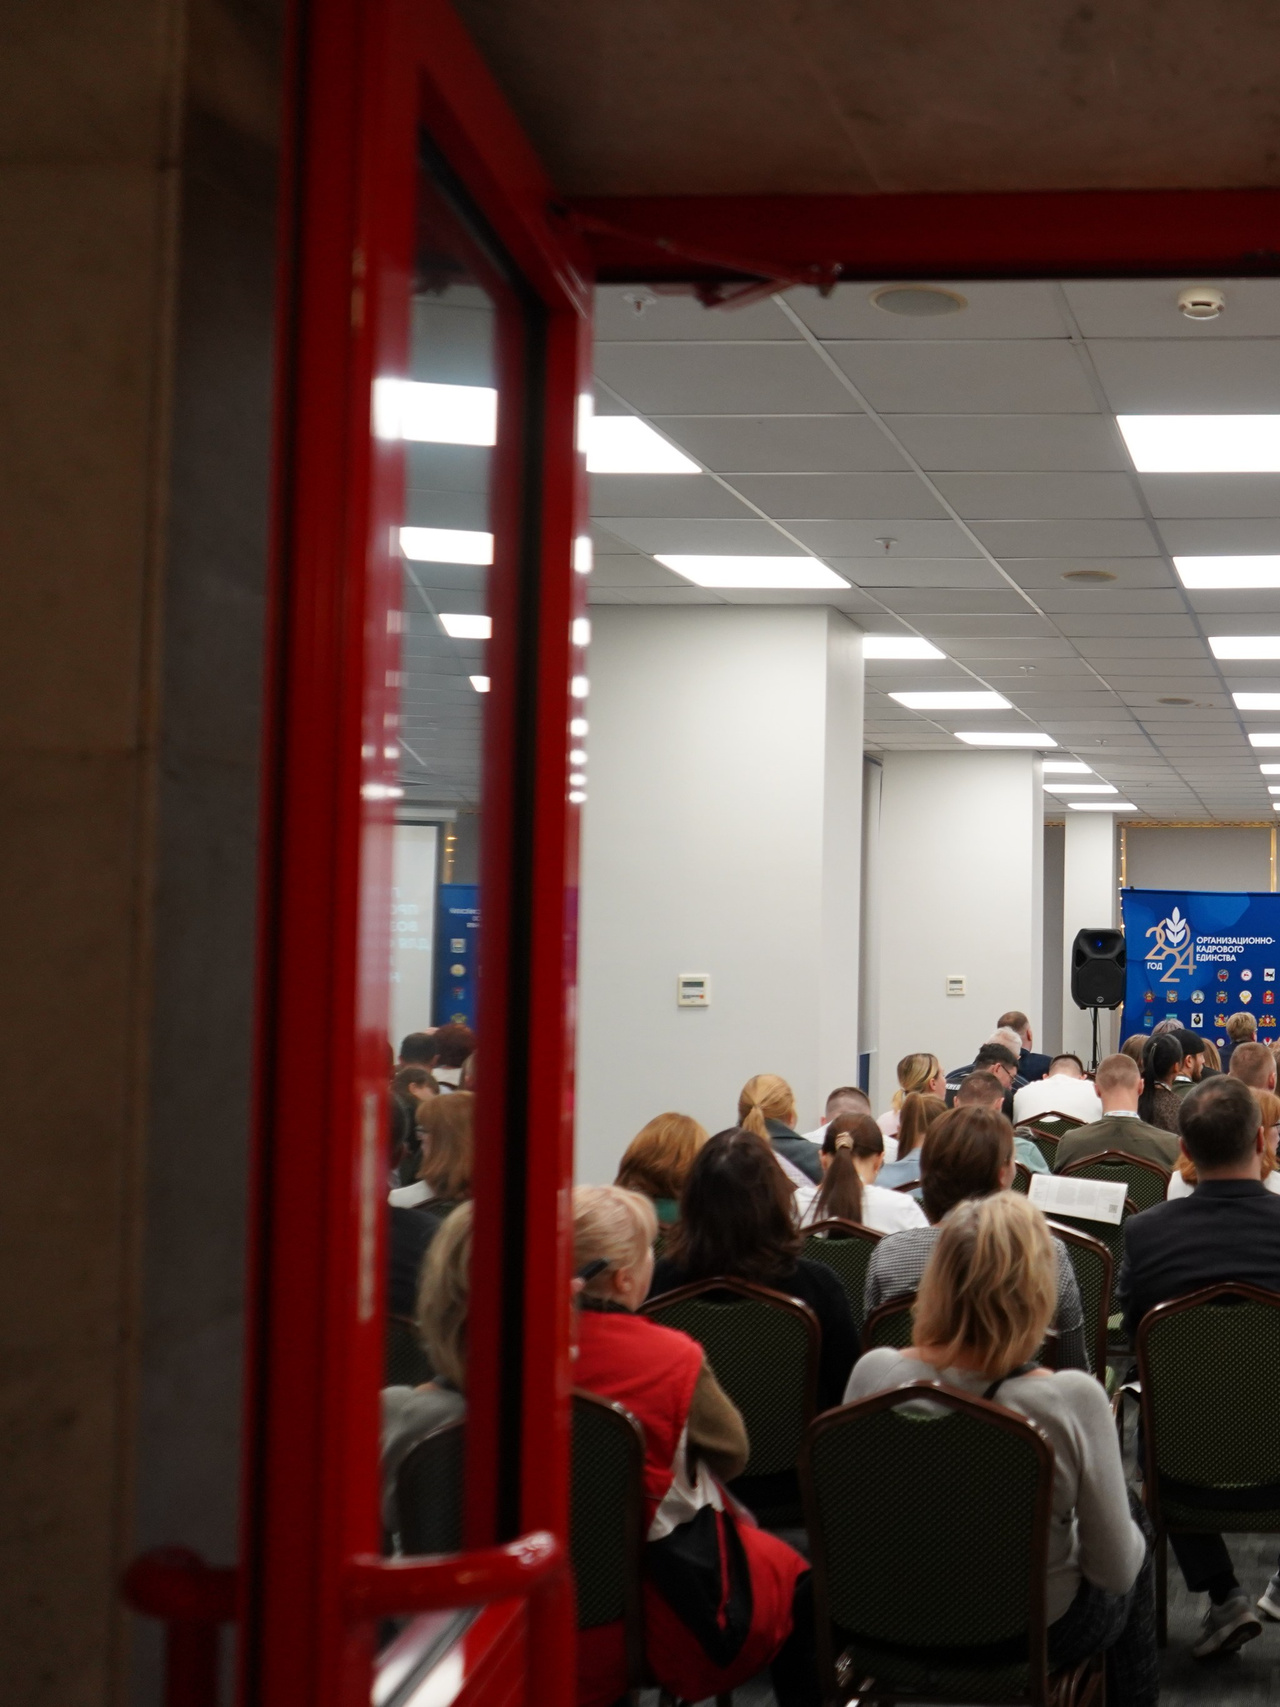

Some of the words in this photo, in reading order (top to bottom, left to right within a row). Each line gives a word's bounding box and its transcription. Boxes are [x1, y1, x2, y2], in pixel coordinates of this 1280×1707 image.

[1196, 936, 1276, 945] ОРГАНИЗАЦИОННО-
[1196, 945, 1245, 953] КАДРОВОГО
[1196, 954, 1237, 962] ЕДИНСТВА
[1146, 962, 1163, 971] ГОД
